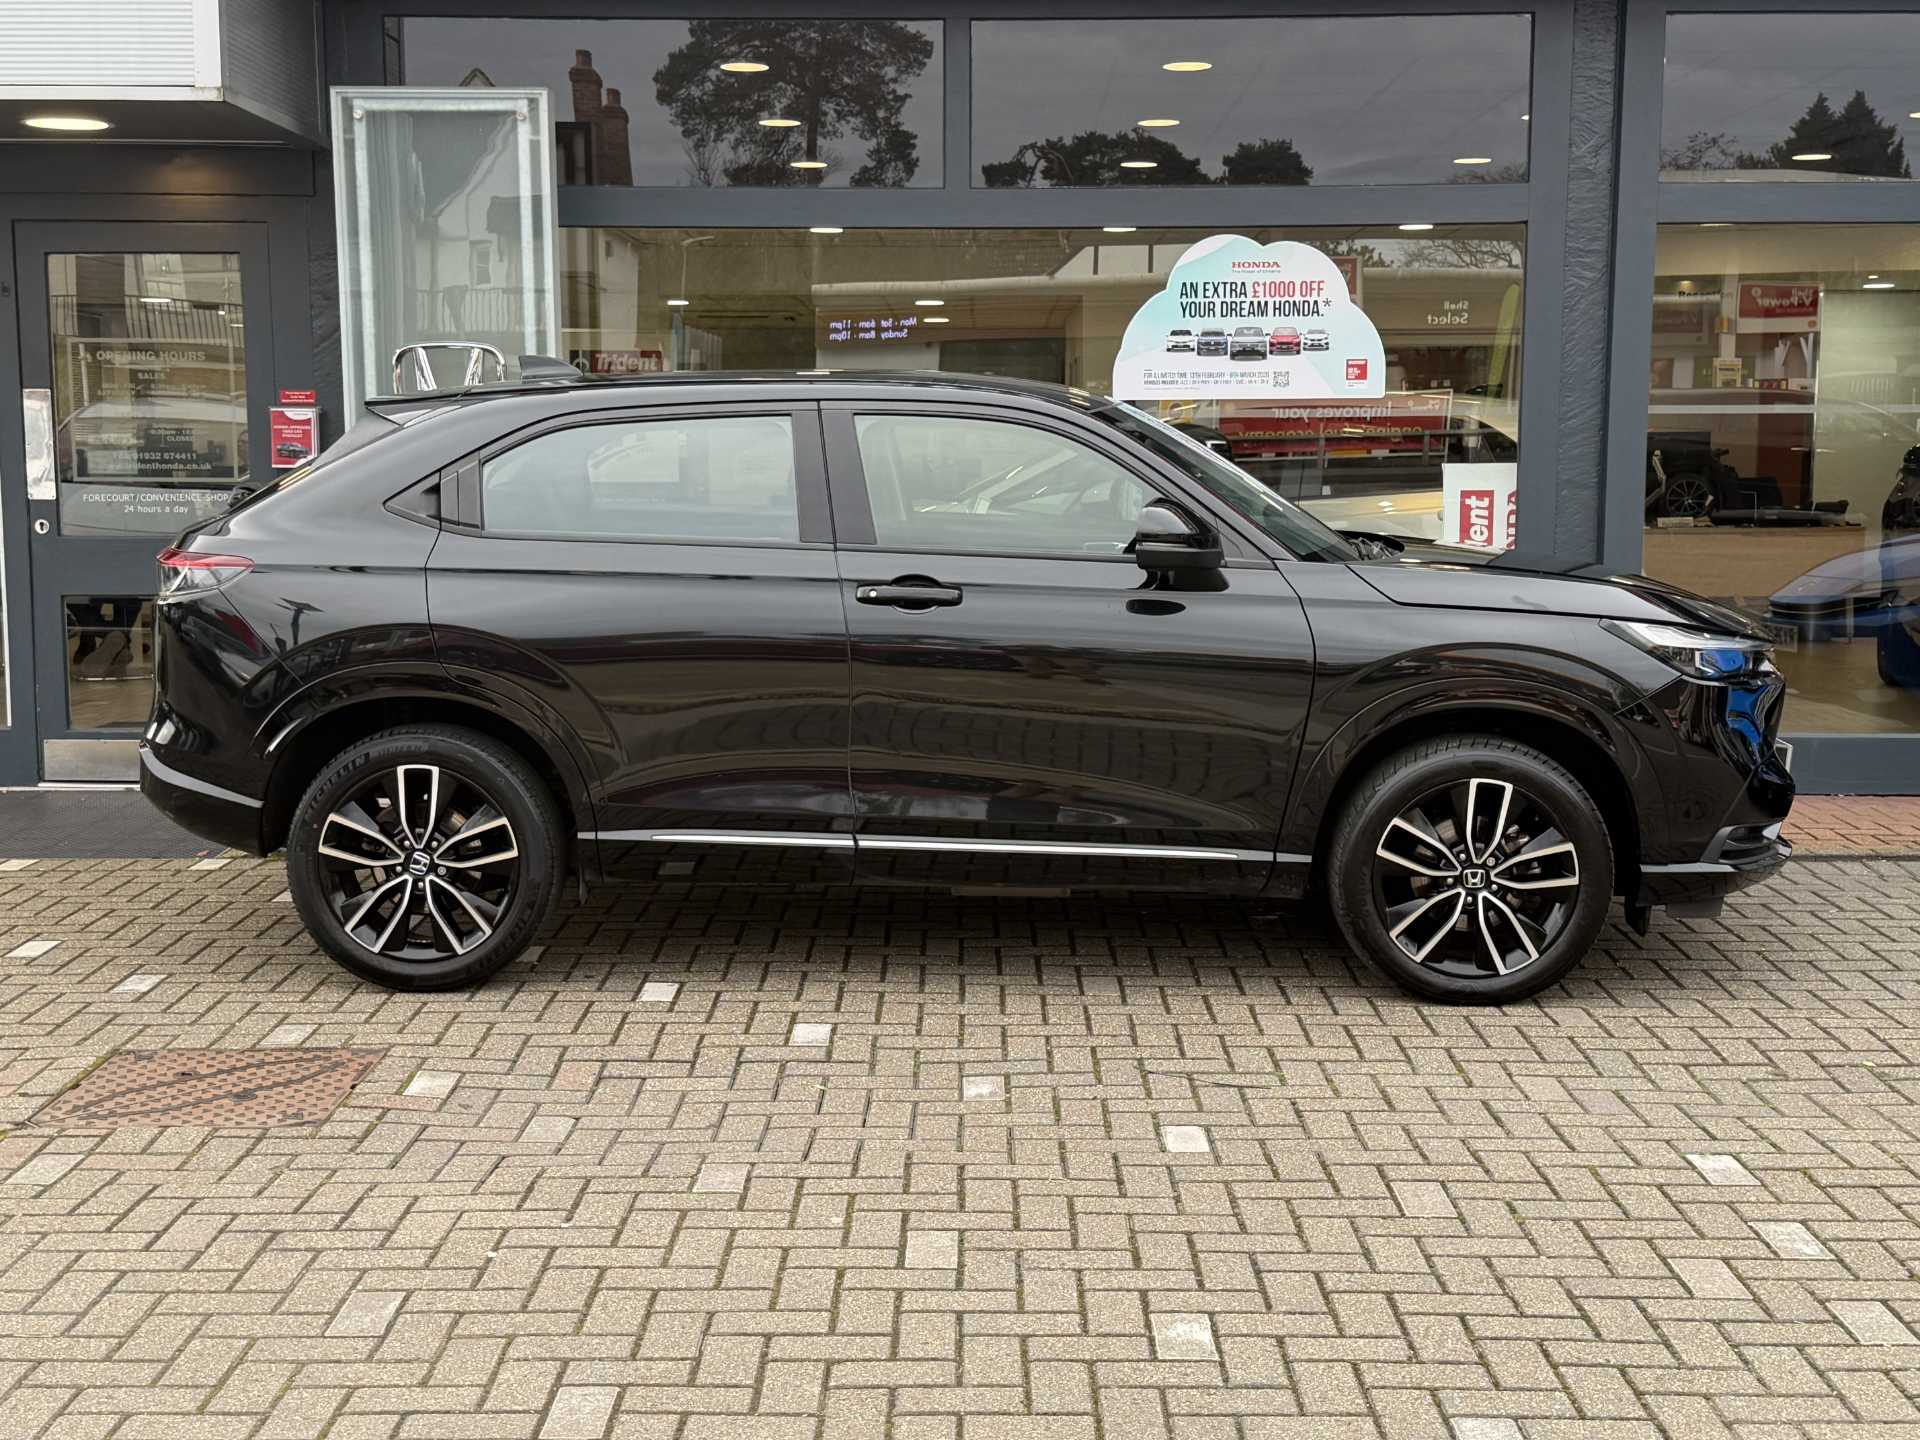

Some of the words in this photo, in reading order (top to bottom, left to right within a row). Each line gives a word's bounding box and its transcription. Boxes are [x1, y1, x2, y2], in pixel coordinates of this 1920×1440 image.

[1232, 261, 1280, 269] HONDA
[1180, 281, 1198, 299] AN
[1203, 281, 1248, 299] EXTRA
[1252, 280, 1295, 298] £1000
[1300, 280, 1325, 298] OFF
[1180, 301, 1216, 318] YOUR
[1221, 300, 1268, 318] DREAM
[96, 351, 156, 361] OPENING
[159, 350, 206, 361] HOURS
[596, 353, 657, 371] Trident
[205, 493, 229, 503] SHOP
[124, 505, 134, 513] 24
[137, 505, 162, 513] hours
[173, 505, 189, 514] day
